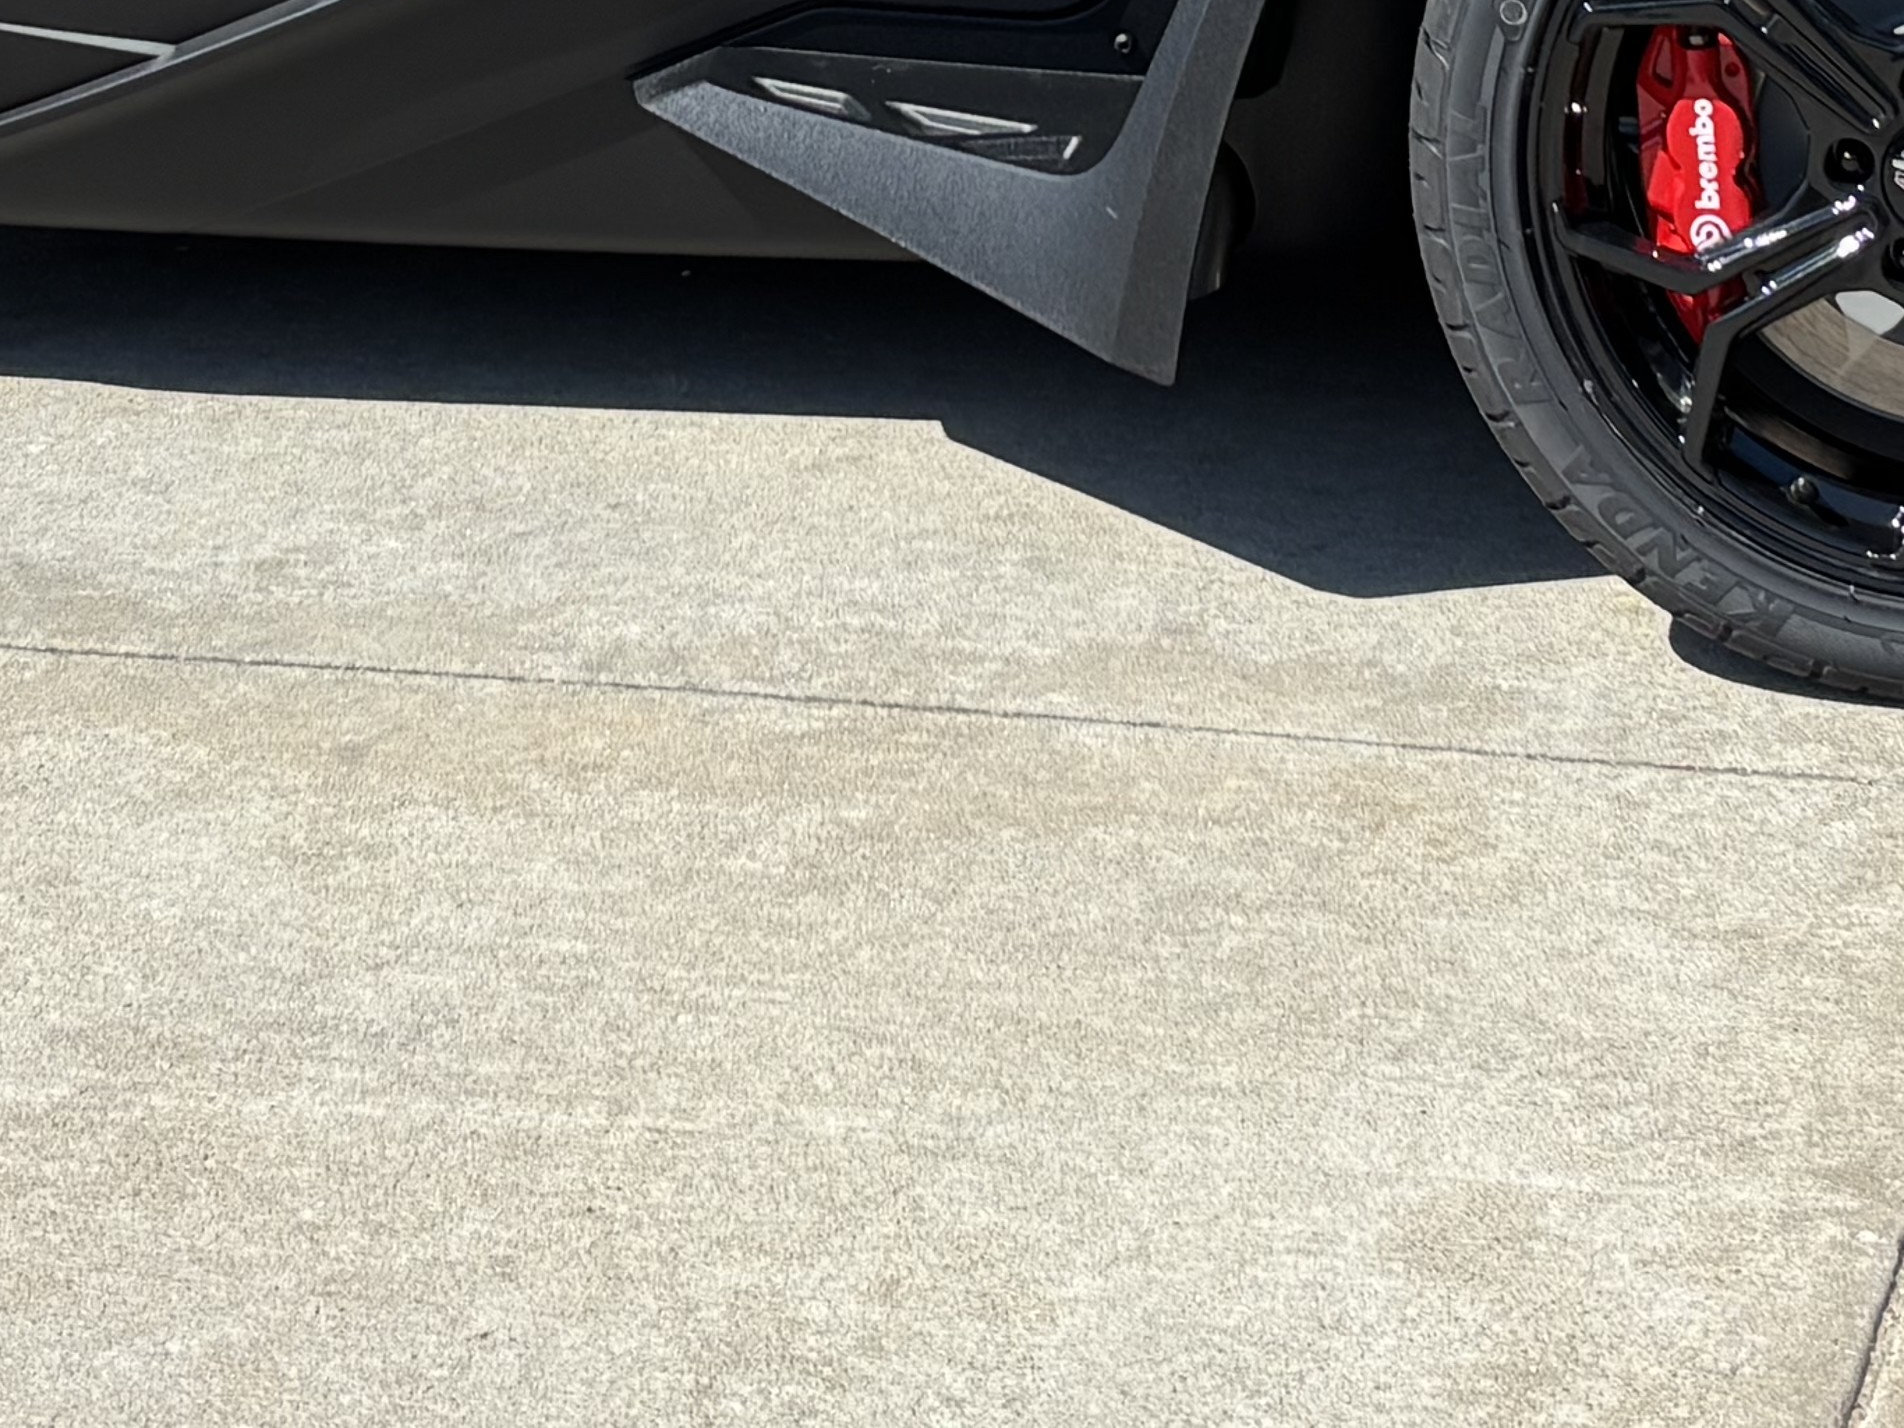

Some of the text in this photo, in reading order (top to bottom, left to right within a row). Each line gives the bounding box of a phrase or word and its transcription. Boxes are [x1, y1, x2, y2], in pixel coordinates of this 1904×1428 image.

[1688, 98, 1721, 211] brembo
[1446, 101, 1796, 640] KENDA RADIAL
